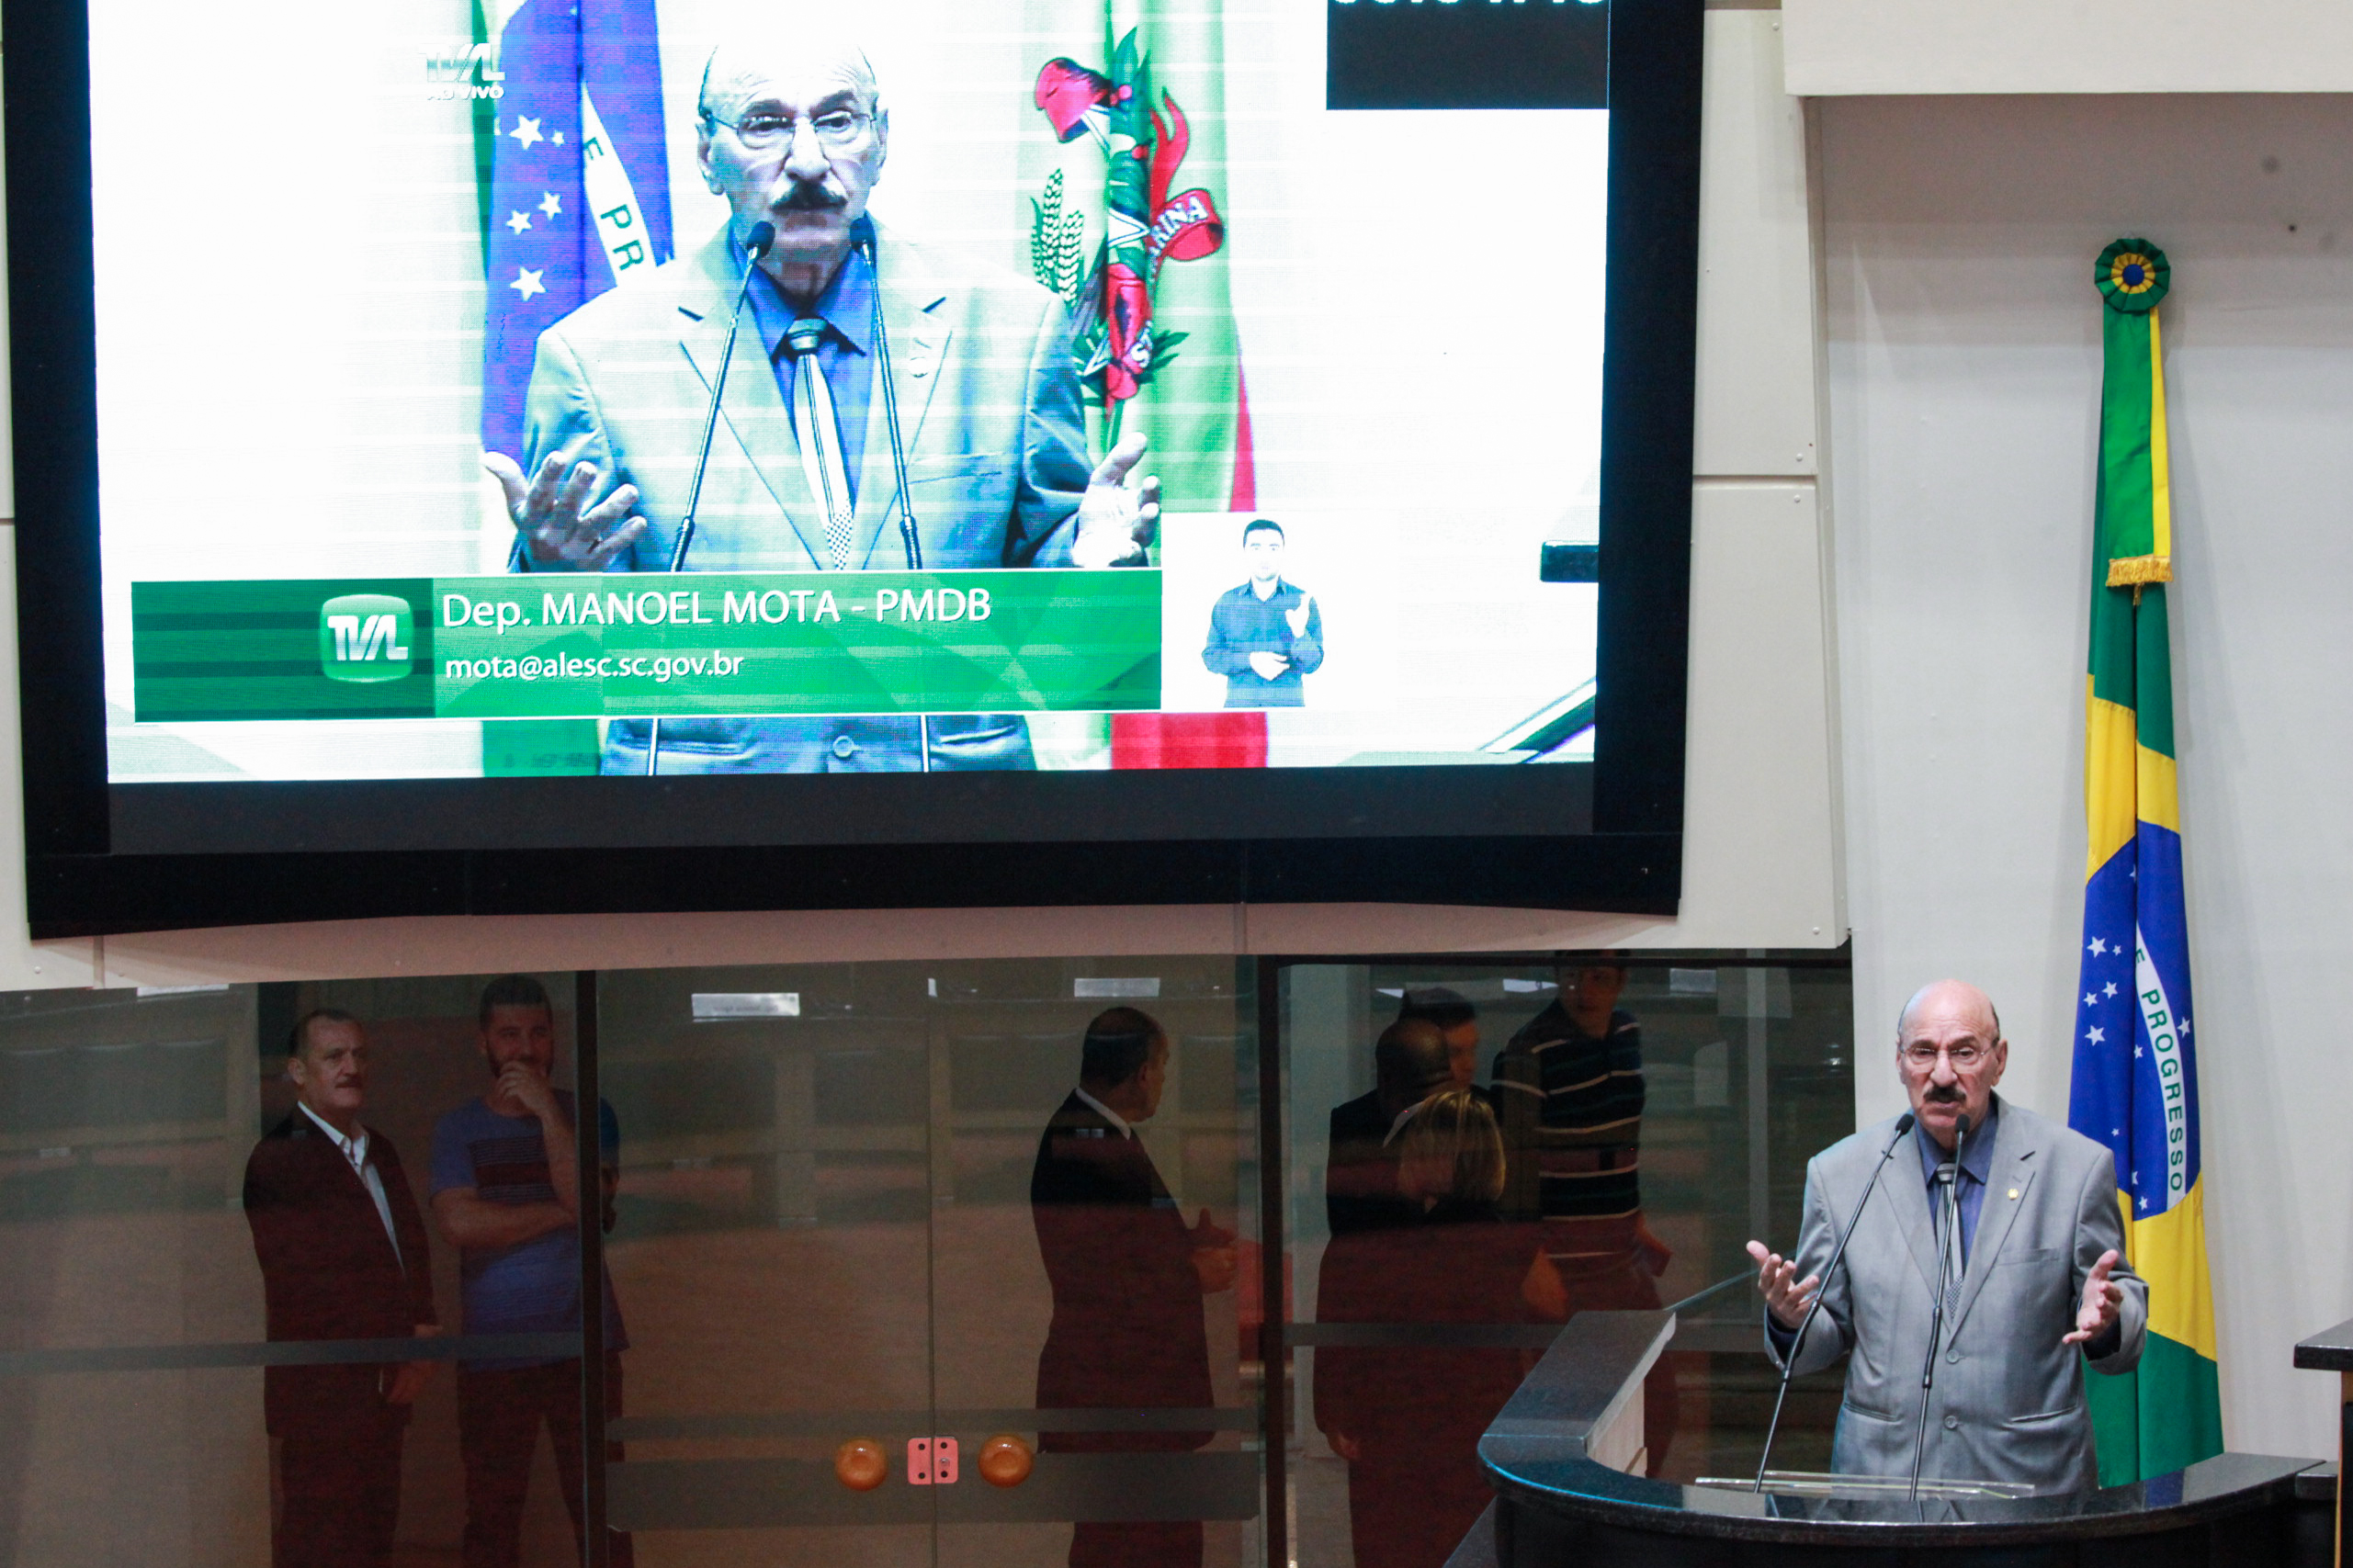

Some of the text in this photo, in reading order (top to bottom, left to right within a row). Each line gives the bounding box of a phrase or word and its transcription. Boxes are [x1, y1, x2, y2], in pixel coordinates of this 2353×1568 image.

[458, 85, 504, 100] VIVO
[443, 593, 531, 636] Dep.
[542, 591, 713, 626] MANOEL
[722, 589, 843, 624] MOTA
[876, 588, 992, 623] PMDB
[446, 650, 745, 683] mota@alesc.sc.gov.br
[2142, 988, 2184, 1192] PROGRESSO
